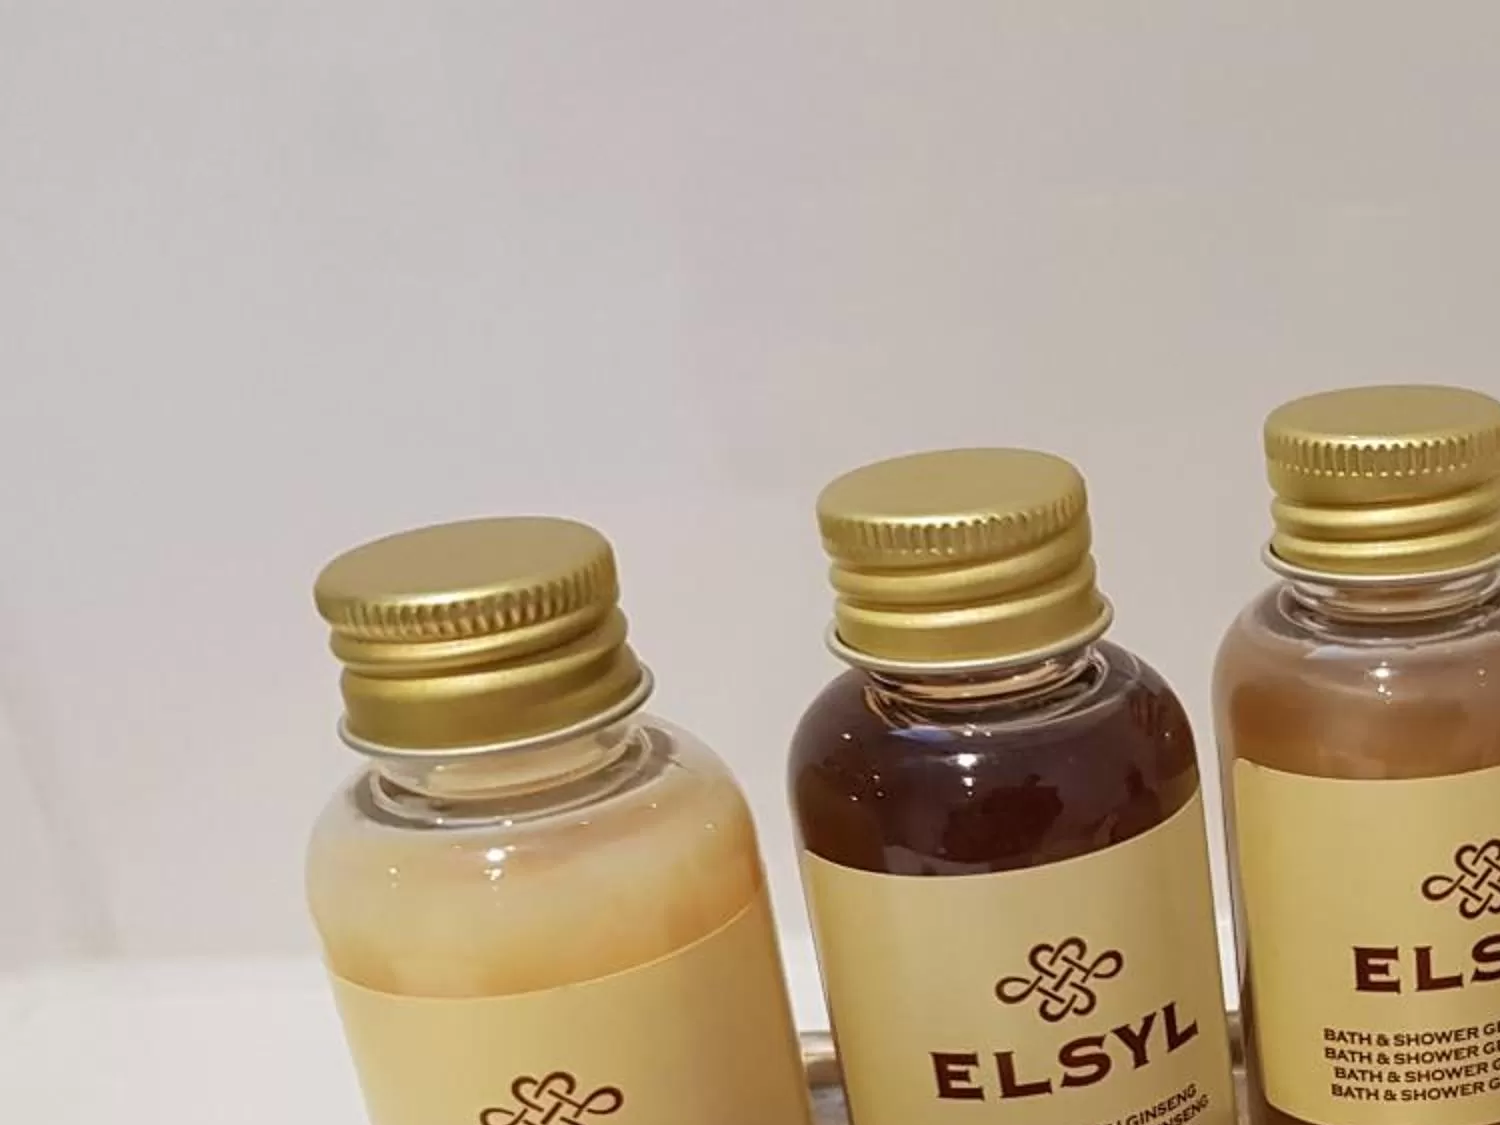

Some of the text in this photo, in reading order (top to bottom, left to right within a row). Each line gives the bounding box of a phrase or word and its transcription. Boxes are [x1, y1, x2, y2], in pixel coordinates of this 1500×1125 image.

[1324, 1027, 1371, 1047] BATH
[1376, 1033, 1390, 1047] &
[1393, 1027, 1479, 1047] SHOWER
[930, 1000, 1199, 1101] ELSYL
[1324, 1046, 1373, 1065] BATH
[1377, 1052, 1390, 1065] &
[1393, 1045, 1480, 1065] SHOWER
[1334, 1064, 1383, 1083] BATH
[1387, 1070, 1401, 1083] &
[1404, 1062, 1489, 1083] SHOWER
[1331, 1083, 1380, 1102] BATH
[1383, 1089, 1398, 1102] &
[1401, 1081, 1485, 1102] SHOWER
